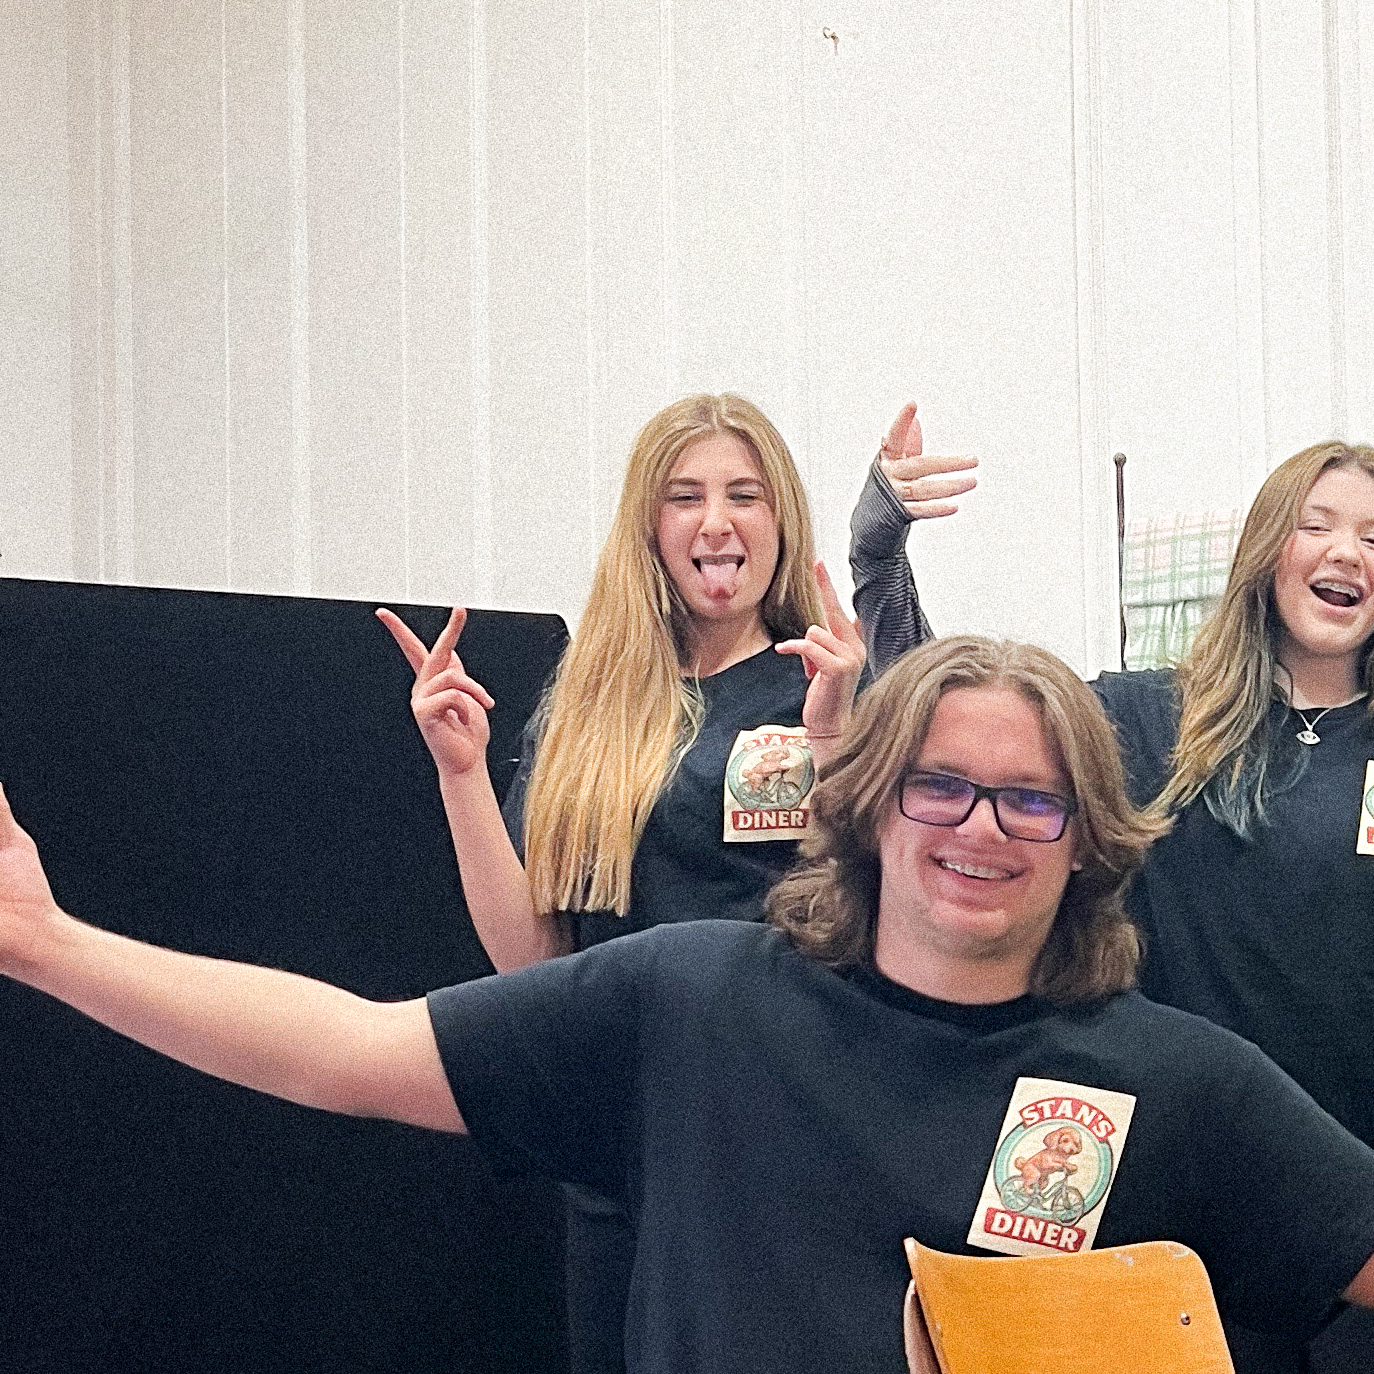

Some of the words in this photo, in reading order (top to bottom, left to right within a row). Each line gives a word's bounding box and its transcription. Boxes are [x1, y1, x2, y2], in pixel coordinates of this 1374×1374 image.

[738, 810, 805, 829] DINER
[1021, 1099, 1114, 1139] STAN'S
[990, 1211, 1079, 1250] DINER
